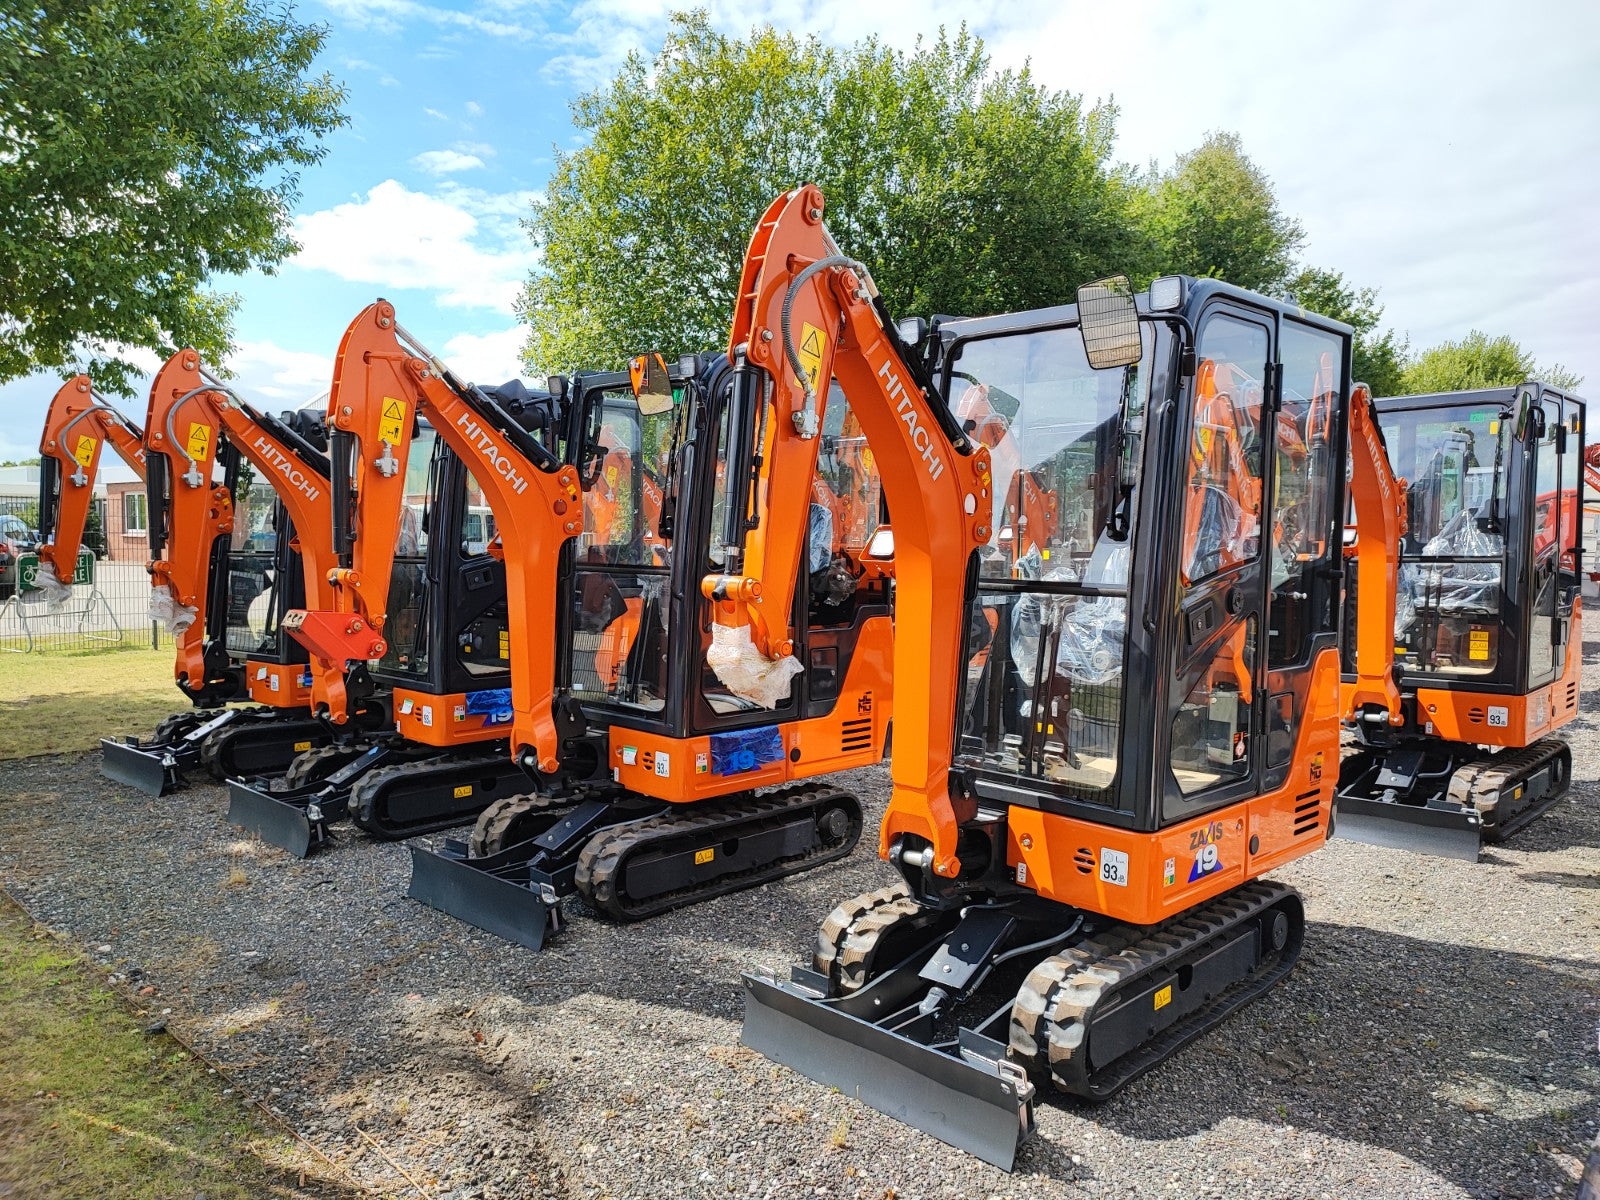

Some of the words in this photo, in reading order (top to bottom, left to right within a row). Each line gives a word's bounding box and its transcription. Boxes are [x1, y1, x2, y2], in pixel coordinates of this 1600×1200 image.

[878, 359, 944, 481] HITACHI
[253, 436, 320, 501] HITACHI
[457, 412, 528, 495] HITACHI
[1367, 433, 1390, 499] HITACHI
[1489, 714, 1501, 725] 93
[656, 762, 665, 775] 93
[730, 750, 756, 770] 19
[1189, 820, 1223, 851] ZAXIS
[1103, 862, 1118, 881] 93
[1195, 844, 1218, 875] 19
